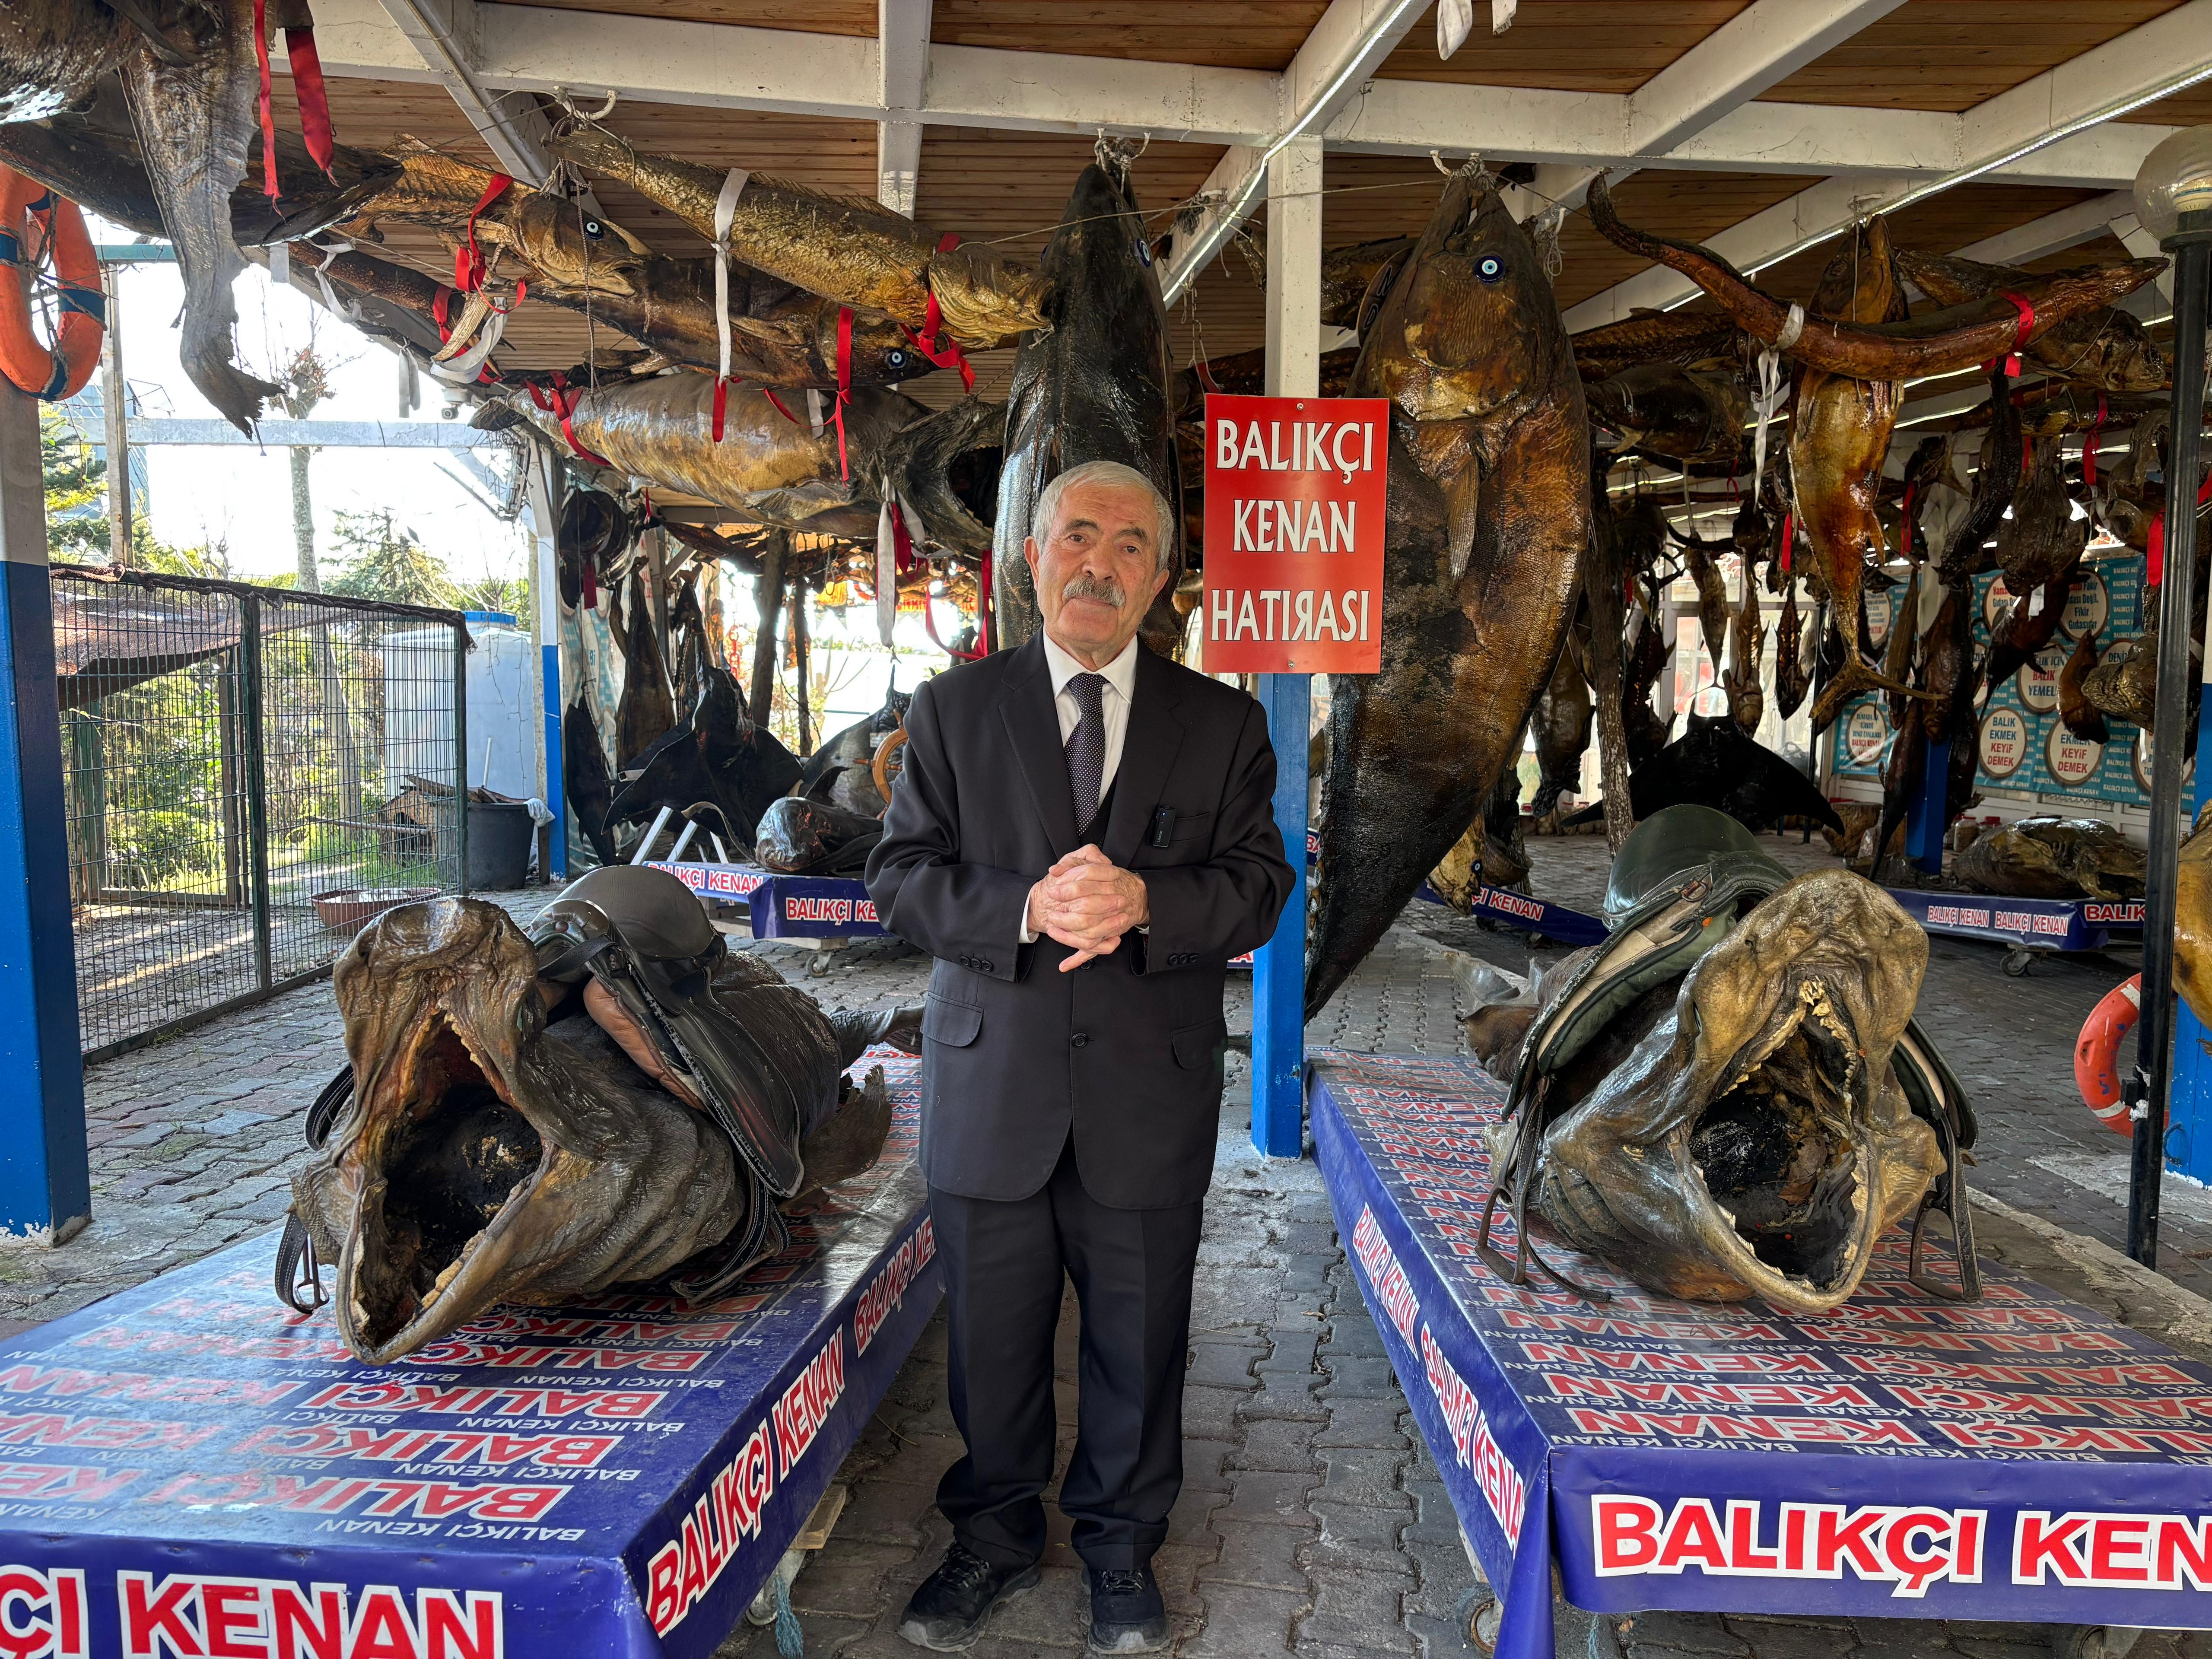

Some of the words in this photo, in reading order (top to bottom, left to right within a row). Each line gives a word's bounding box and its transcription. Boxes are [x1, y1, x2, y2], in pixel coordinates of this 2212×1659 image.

[1216, 419, 1373, 484] BALIKÇI
[1233, 499, 1356, 553] KENAN
[2033, 670, 2055, 681] BALIK
[1993, 717, 2016, 727] BALIK
[1990, 730, 2017, 740] EKMEK
[1991, 742, 2013, 753] KEYİF
[2062, 748, 2087, 760] KEYİF
[1988, 756, 2014, 766] DEMEK
[2058, 761, 2088, 773] DEMEK
[709, 870, 763, 895] KENAN
[785, 897, 852, 925] BALIKÇI
[1488, 890, 1544, 922] KENAN
[1927, 906, 1958, 927] BALIKÇI
[1959, 908, 1989, 928] KENAN
[1994, 911, 2031, 935] BALIKÇI
[2032, 914, 2069, 936] KENAN
[1397, 1197, 1463, 1209] KENAN
[855, 1234, 913, 1358] BALIKÇI
[1380, 1253, 1421, 1363] KENAN
[1463, 1299, 1548, 1313] KENAN
[456, 1314, 744, 1340] BALIKÇ
[1496, 1309, 1789, 1340] KENAN
[569, 1338, 663, 1347] KENAN
[1483, 1330, 1574, 1342] KENAN
[1793, 1321, 2136, 1352] BALIKÇI
[666, 1339, 764, 1348] BALIKÇI
[1582, 1338, 1684, 1351] BALIKÇI
[389, 1341, 713, 1372] BALIKÇ
[1518, 1342, 1835, 1373] KENAN
[1830, 1345, 1938, 1359] BALIKÇI
[2093, 1355, 2199, 1363] BALIKÇI
[1503, 1361, 1600, 1375] KENAN
[1835, 1352, 2206, 1386] BALIKÇI
[514, 1375, 611, 1386] KENAN
[617, 1376, 725, 1388] BALIKÇI
[1608, 1370, 1719, 1381] BALIKÇI
[1765, 1374, 1867, 1382] KENAN
[1873, 1375, 1989, 1389] BALIKÇI
[1540, 1372, 1881, 1407] KENAN
[2044, 1386, 2148, 1395] KENAN
[294, 1380, 670, 1419] BALIKÇI
[1524, 1395, 1628, 1408] KENAN
[1637, 1401, 1755, 1413] BALIKÇI
[1804, 1406, 1913, 1417] KENAN
[283, 1411, 401, 1424] BALIKÇI
[456, 1417, 563, 1430] KENAN
[2099, 1417, 2212, 1427] KENAN
[567, 1418, 686, 1432] BALIKÇI
[1565, 1408, 1932, 1446] KENAN
[230, 1422, 625, 1468] BALIKÇI
[1421, 1320, 1478, 1470] BALIKÇI
[1472, 1409, 1526, 1559] KENA
[1550, 1435, 1663, 1447] KENAN
[1672, 1437, 1800, 1452] BALIKÇI
[1853, 1445, 1970, 1459] KENAN
[1977, 1448, 2106, 1462] BALIKÇI
[393, 1462, 510, 1478] KENAN
[513, 1466, 642, 1481] BALIKÇI
[647, 1417, 772, 1639] BALIKÇI
[772, 1323, 845, 1482] KENAN
[314, 1519, 443, 1536] KENAN
[444, 1522, 587, 1541] BALIKÇI
[1591, 1494, 1987, 1598] BALIKÇI
[117, 1570, 502, 1659] KENAN
